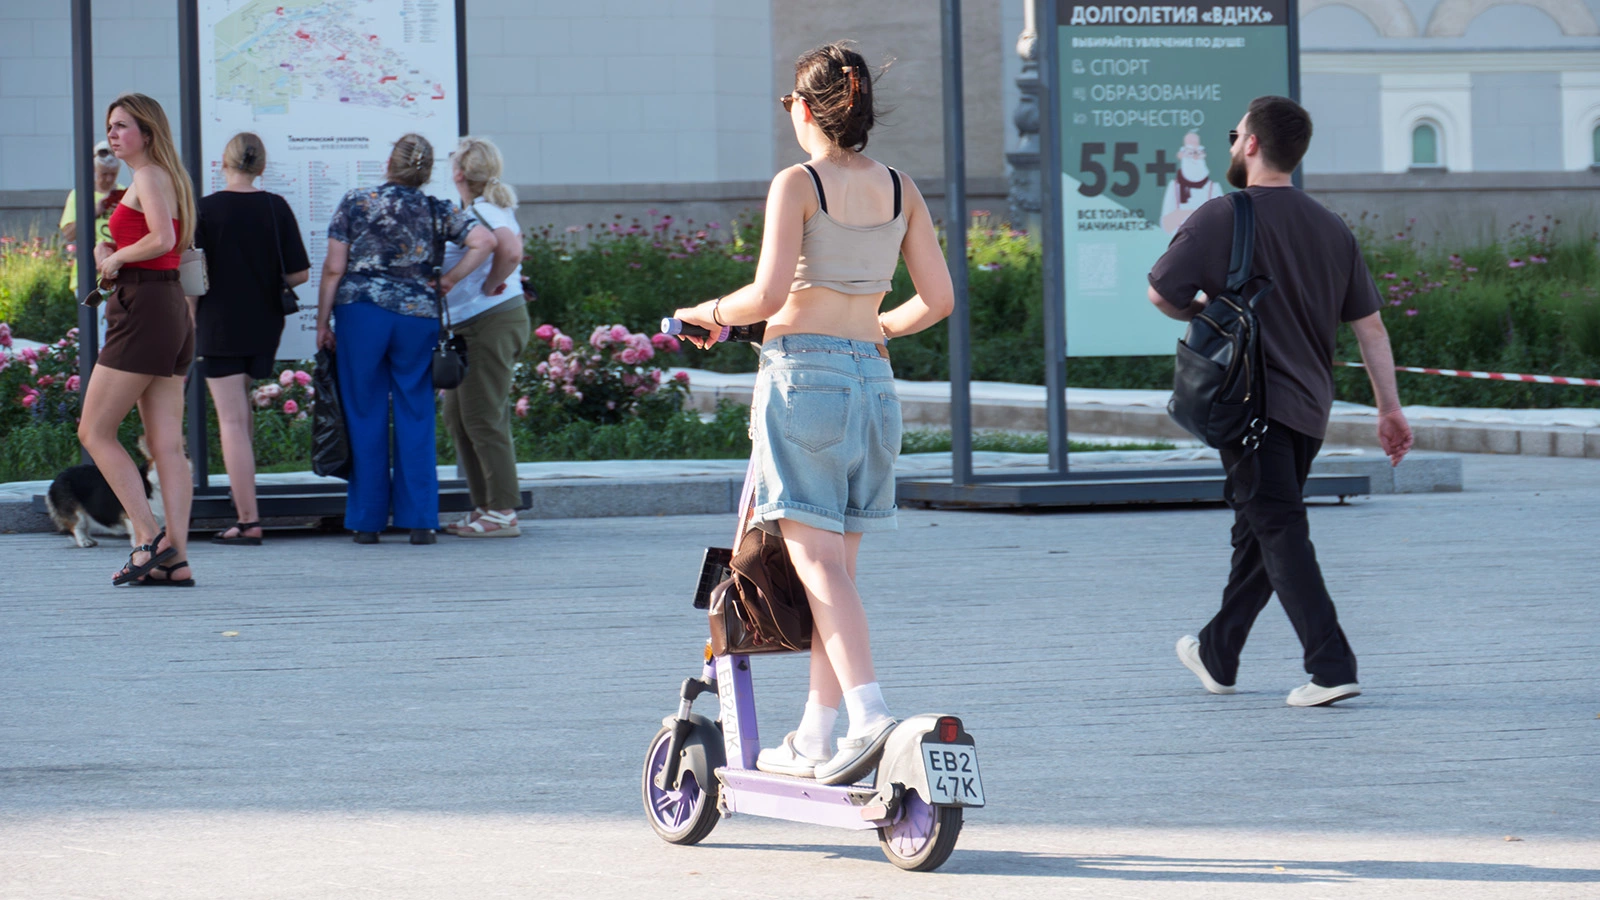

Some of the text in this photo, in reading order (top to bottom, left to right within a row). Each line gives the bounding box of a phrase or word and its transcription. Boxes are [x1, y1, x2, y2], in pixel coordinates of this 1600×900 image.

[1070, 6, 1274, 25] ДОЛГОЛЕТИЯ «ВДНХ»
[1072, 36, 1133, 48] ВЫБИРАЙТЕ
[1135, 37, 1194, 48] УВЛЕЧЕНИЕ
[1195, 37, 1211, 48] ПО
[1090, 59, 1150, 76] СПОРТ
[1091, 84, 1221, 101] ОБРАЗОВАНИЕ
[1092, 109, 1205, 127] ТВОРЧЕСТВО
[1077, 142, 1176, 197] 55+
[1078, 208, 1145, 219] ВСЕ ТОЛЬКО
[929, 750, 972, 773] EB2
[936, 776, 977, 798] 47K
